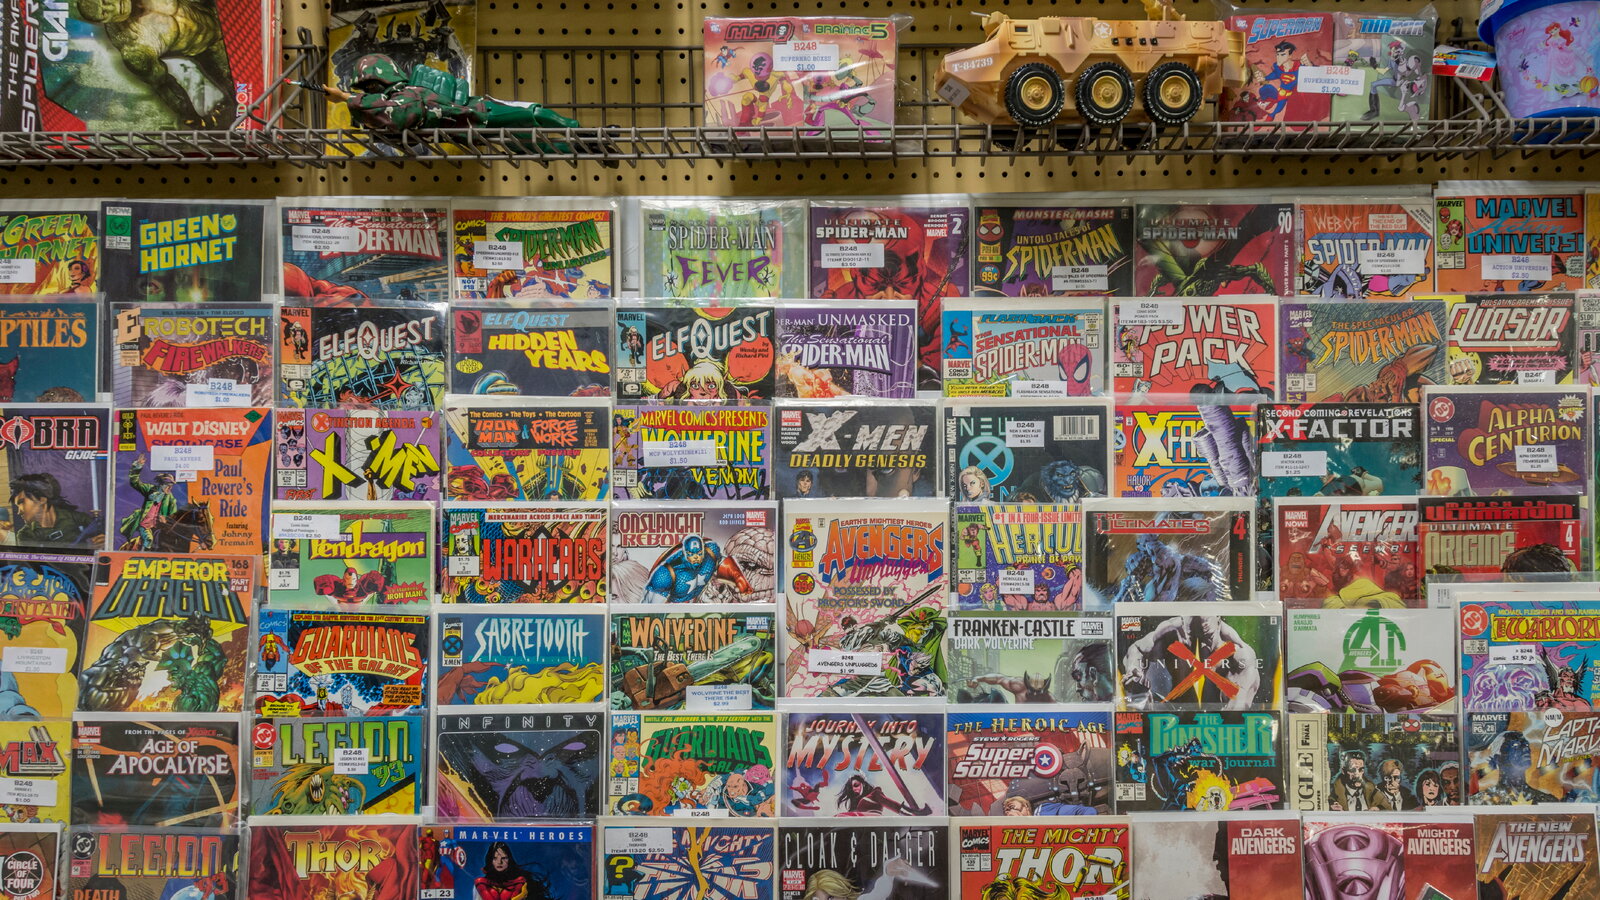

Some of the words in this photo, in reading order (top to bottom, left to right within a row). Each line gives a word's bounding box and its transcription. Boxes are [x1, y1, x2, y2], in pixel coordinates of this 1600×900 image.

[1248, 17, 1324, 44] SUPERMAN
[794, 42, 817, 51] B248
[952, 58, 993, 72] T-84739
[1326, 66, 1350, 75] B248
[8, 52, 19, 99] THE
[1436, 200, 1463, 208] MARVEL
[1475, 197, 1578, 219] MARVEL
[324, 217, 352, 228] The
[355, 217, 437, 229] Sensational
[490, 213, 506, 221] THE
[824, 218, 901, 226] ULTIMATE
[1278, 211, 1292, 234] 90
[4, 214, 87, 245] GREEN
[139, 214, 219, 248] GREEN
[455, 219, 487, 231] COMICS
[667, 226, 776, 251] SPIDER-MAN
[816, 226, 909, 239] SPIDER-MAN
[926, 229, 947, 237] MARVEL
[1016, 233, 1052, 245] UNTOLD
[1142, 227, 1239, 240] SPIDER-MAN
[139, 236, 237, 274] HORNET
[675, 254, 772, 286] FEVER
[281, 309, 309, 317] MARVEL
[617, 312, 645, 321] MARVEL
[818, 313, 911, 326] UNMASKED
[144, 317, 265, 336] ROBOTECH
[487, 329, 578, 350] HIDDEN
[976, 325, 1081, 353] SENSATIONAL
[1314, 311, 1443, 368] SPIDER-MAN
[143, 339, 266, 373] FIREWALKERS
[524, 349, 611, 374] YEARS
[1149, 337, 1258, 378] PACK
[210, 381, 232, 391] B248
[641, 409, 677, 427] MARVEL
[679, 409, 718, 427] COMICS
[719, 410, 769, 427] PRESENTS
[1266, 409, 1301, 417] SECOND
[1303, 409, 1340, 417] COMING
[1348, 408, 1412, 418] REVELATIONS
[375, 417, 416, 428] AGENDA
[530, 418, 579, 431] FORCE
[1488, 407, 1556, 434] ALPHA
[145, 421, 190, 436] WALT
[791, 410, 929, 452] X-MEN
[1266, 418, 1413, 439] X-FACTOR
[151, 439, 243, 449] SHOWCASE
[530, 427, 579, 447] WORKS
[537, 448, 581, 456] PREVIEW
[1468, 425, 1581, 467] CENTURION
[215, 458, 242, 477] Paul
[669, 457, 688, 465] $1.50
[789, 453, 852, 468] DEADLY
[854, 453, 927, 468] GENESIS
[690, 467, 759, 491] VENOM
[202, 477, 252, 496] Revere's
[219, 499, 247, 517] Ride
[488, 513, 528, 521] MERCENARIES
[958, 514, 984, 522] MARVEL
[1022, 513, 1060, 522] FOUR-ISSUE
[1285, 511, 1308, 520] MARVEL
[618, 512, 705, 534] ONSLAUGHT
[868, 518, 903, 526] MIGHTIEST
[904, 520, 933, 529] HEROES
[1429, 522, 1514, 532] ULTIMATE
[222, 531, 252, 539] Johnny
[1565, 524, 1574, 548] 4
[1424, 531, 1517, 568] ORIGINS
[231, 560, 249, 569] 168
[482, 537, 603, 587] WARHEADS
[1015, 555, 1046, 564] PRINCE
[122, 558, 229, 581] EMPEROR
[230, 578, 249, 586] PART
[92, 577, 247, 620] DRAGON
[387, 592, 403, 602] IRON
[746, 617, 768, 625] MARVEL
[1464, 612, 1481, 628] DC
[629, 616, 738, 652] WOLVERINE
[953, 618, 1076, 639] FRANKEN-CASTLE
[474, 616, 590, 664] SABRETOOTH
[292, 625, 424, 670] GUARDIANS
[443, 659, 462, 667] X-MEN
[666, 651, 684, 661] BEST
[1138, 657, 1264, 669] UNIVERSE
[352, 661, 415, 677] GALAXY
[441, 715, 597, 729] INFINITY
[878, 720, 918, 734] INTO
[992, 717, 1071, 735] HEROIC
[1197, 714, 1227, 726] THE
[257, 730, 271, 742] DC
[1149, 713, 1277, 757] PUNISHER
[140, 738, 174, 753] AGE
[176, 738, 198, 753] OF
[107, 754, 231, 775] APOCALYPSE
[952, 760, 1035, 779] Soldier
[1188, 758, 1215, 768] war
[1223, 757, 1276, 769] journal
[961, 828, 990, 838] MARVEL
[1240, 827, 1285, 837] DARK
[1416, 828, 1460, 838] MIGHTY
[1509, 822, 1537, 833] THE
[1538, 822, 1572, 832] NEW
[459, 830, 520, 840] MARVEL
[528, 831, 584, 840] HEROES
[1001, 828, 1037, 845] THE
[1041, 827, 1127, 845] MIGHTY
[784, 832, 838, 869] CLOAK
[1230, 837, 1297, 855] AVENGERS
[1407, 838, 1471, 856] AVENGERS
[1481, 821, 1588, 874] AVENGERS
[283, 830, 383, 880] THOR
[7, 860, 38, 870] CIRCLE
[993, 846, 1127, 884] THOR
[17, 870, 27, 878] OF
[782, 870, 805, 879] MARVEL
[7, 878, 35, 889] FOUR
[439, 889, 451, 898] 23
